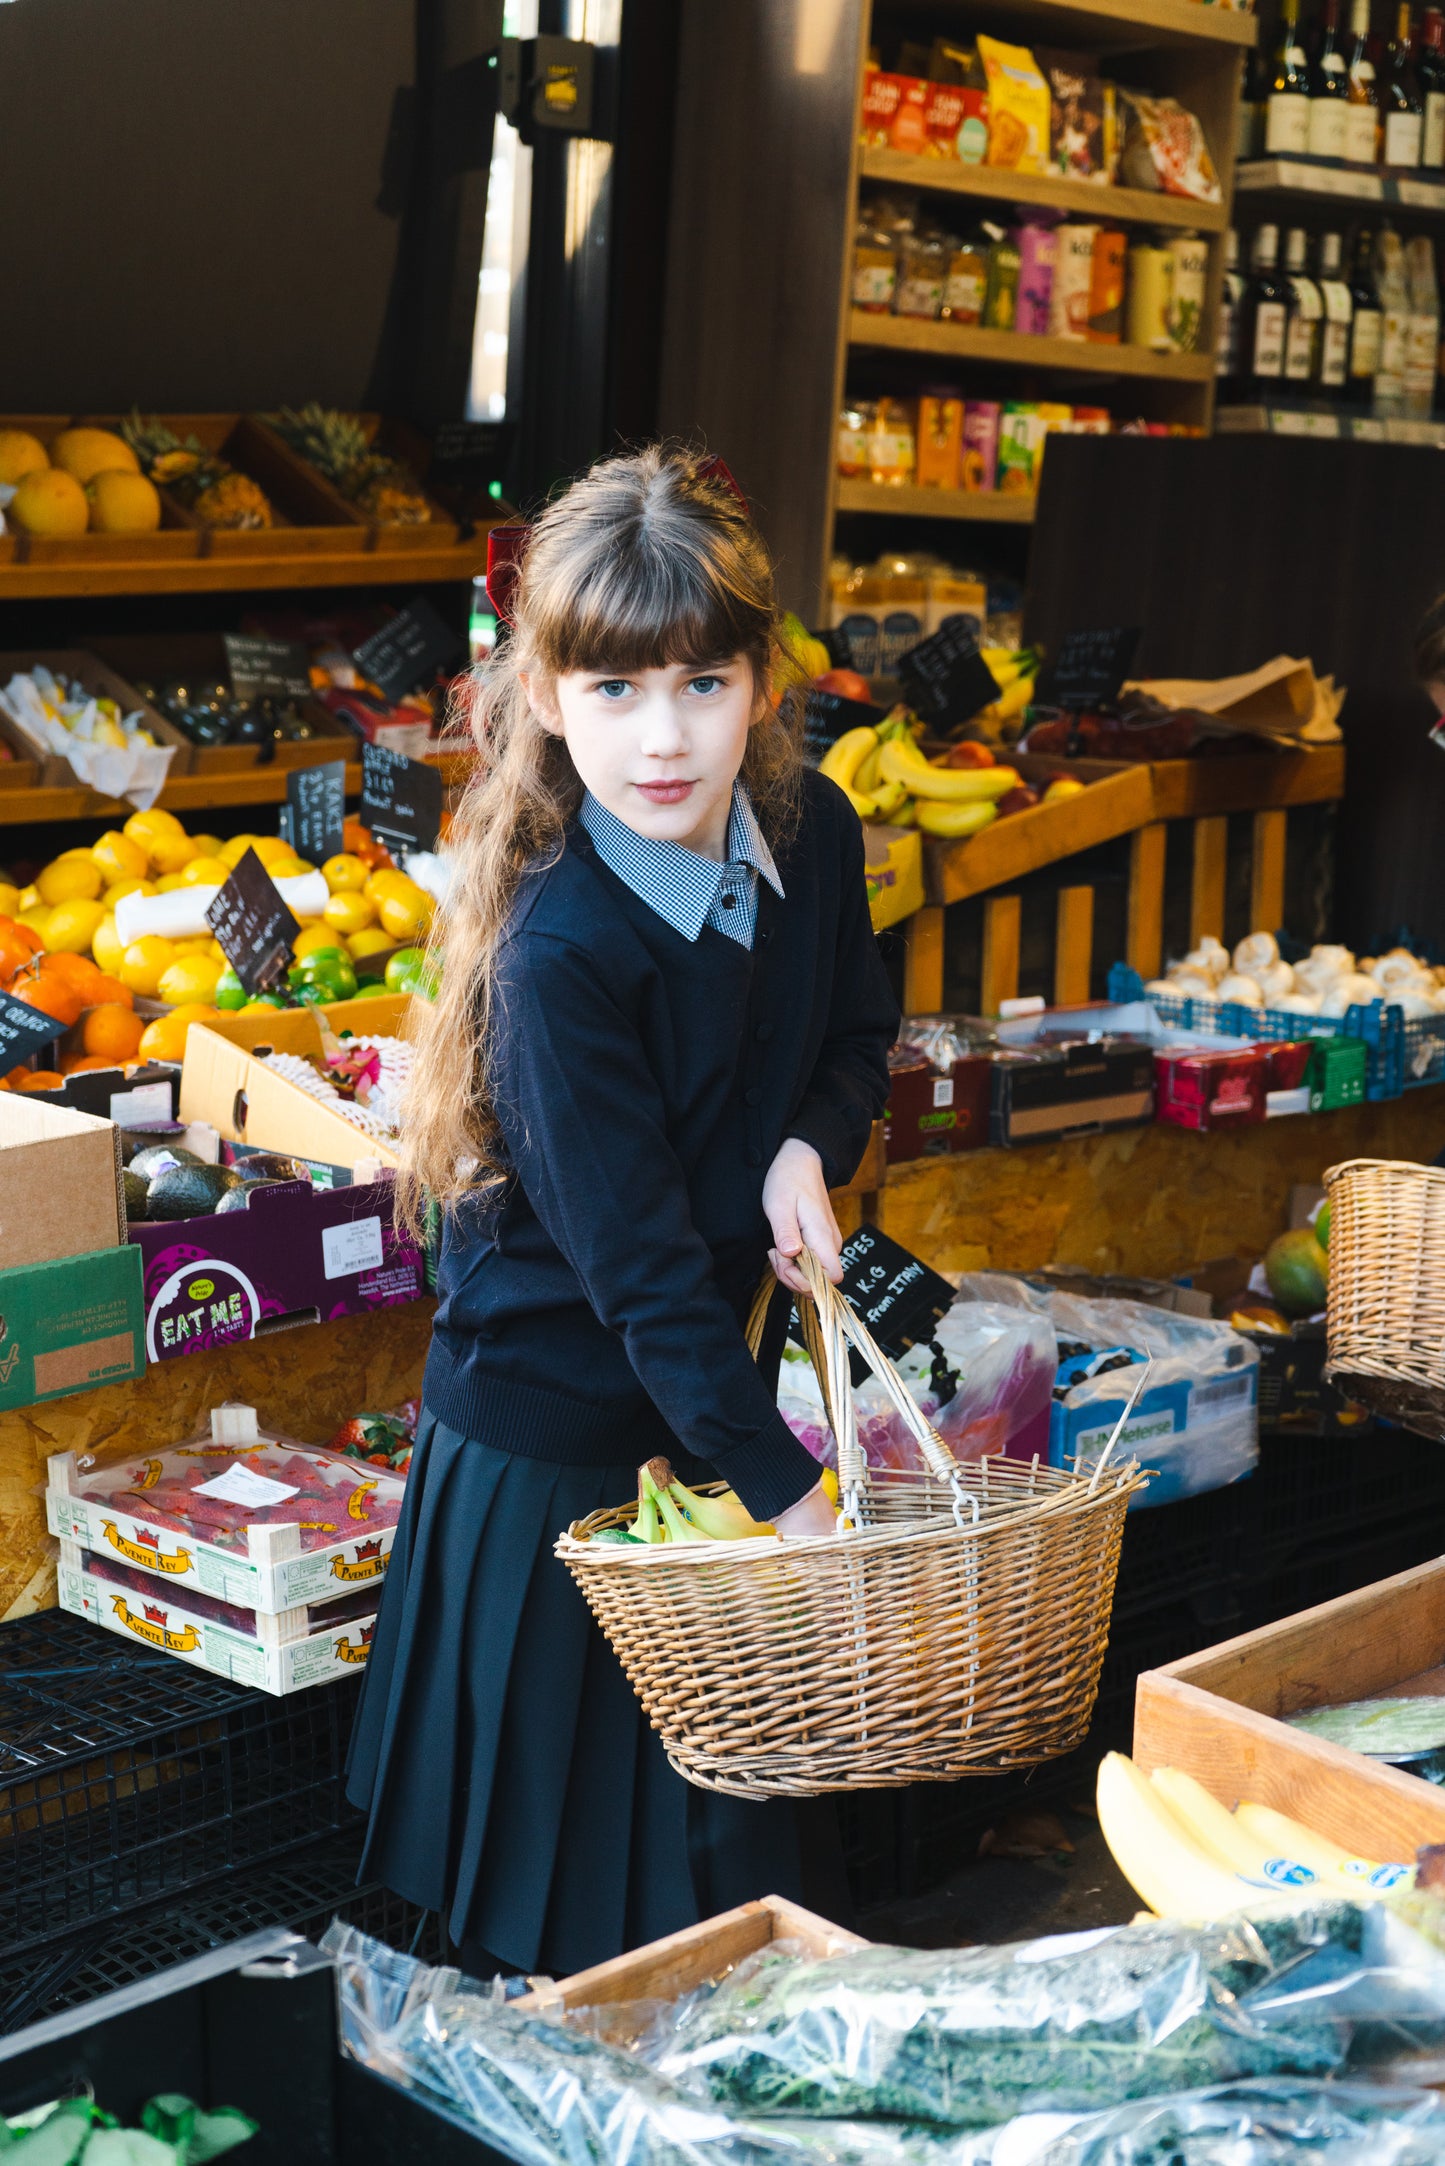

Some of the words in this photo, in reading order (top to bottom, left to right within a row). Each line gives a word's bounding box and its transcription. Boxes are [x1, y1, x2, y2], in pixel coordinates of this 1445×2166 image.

[324, 777, 344, 836] KAKI
[866, 1295, 896, 1324] from
[887, 1262, 925, 1296] ITALY
[93, 1318, 128, 1332] PRODUCT
[161, 1306, 205, 1348] EAT
[209, 1292, 243, 1330] ME
[226, 1319, 245, 1332] TASTY
[102, 1361, 132, 1376] PACKED
[156, 1554, 177, 1570] REY
[163, 1629, 184, 1648] REY
